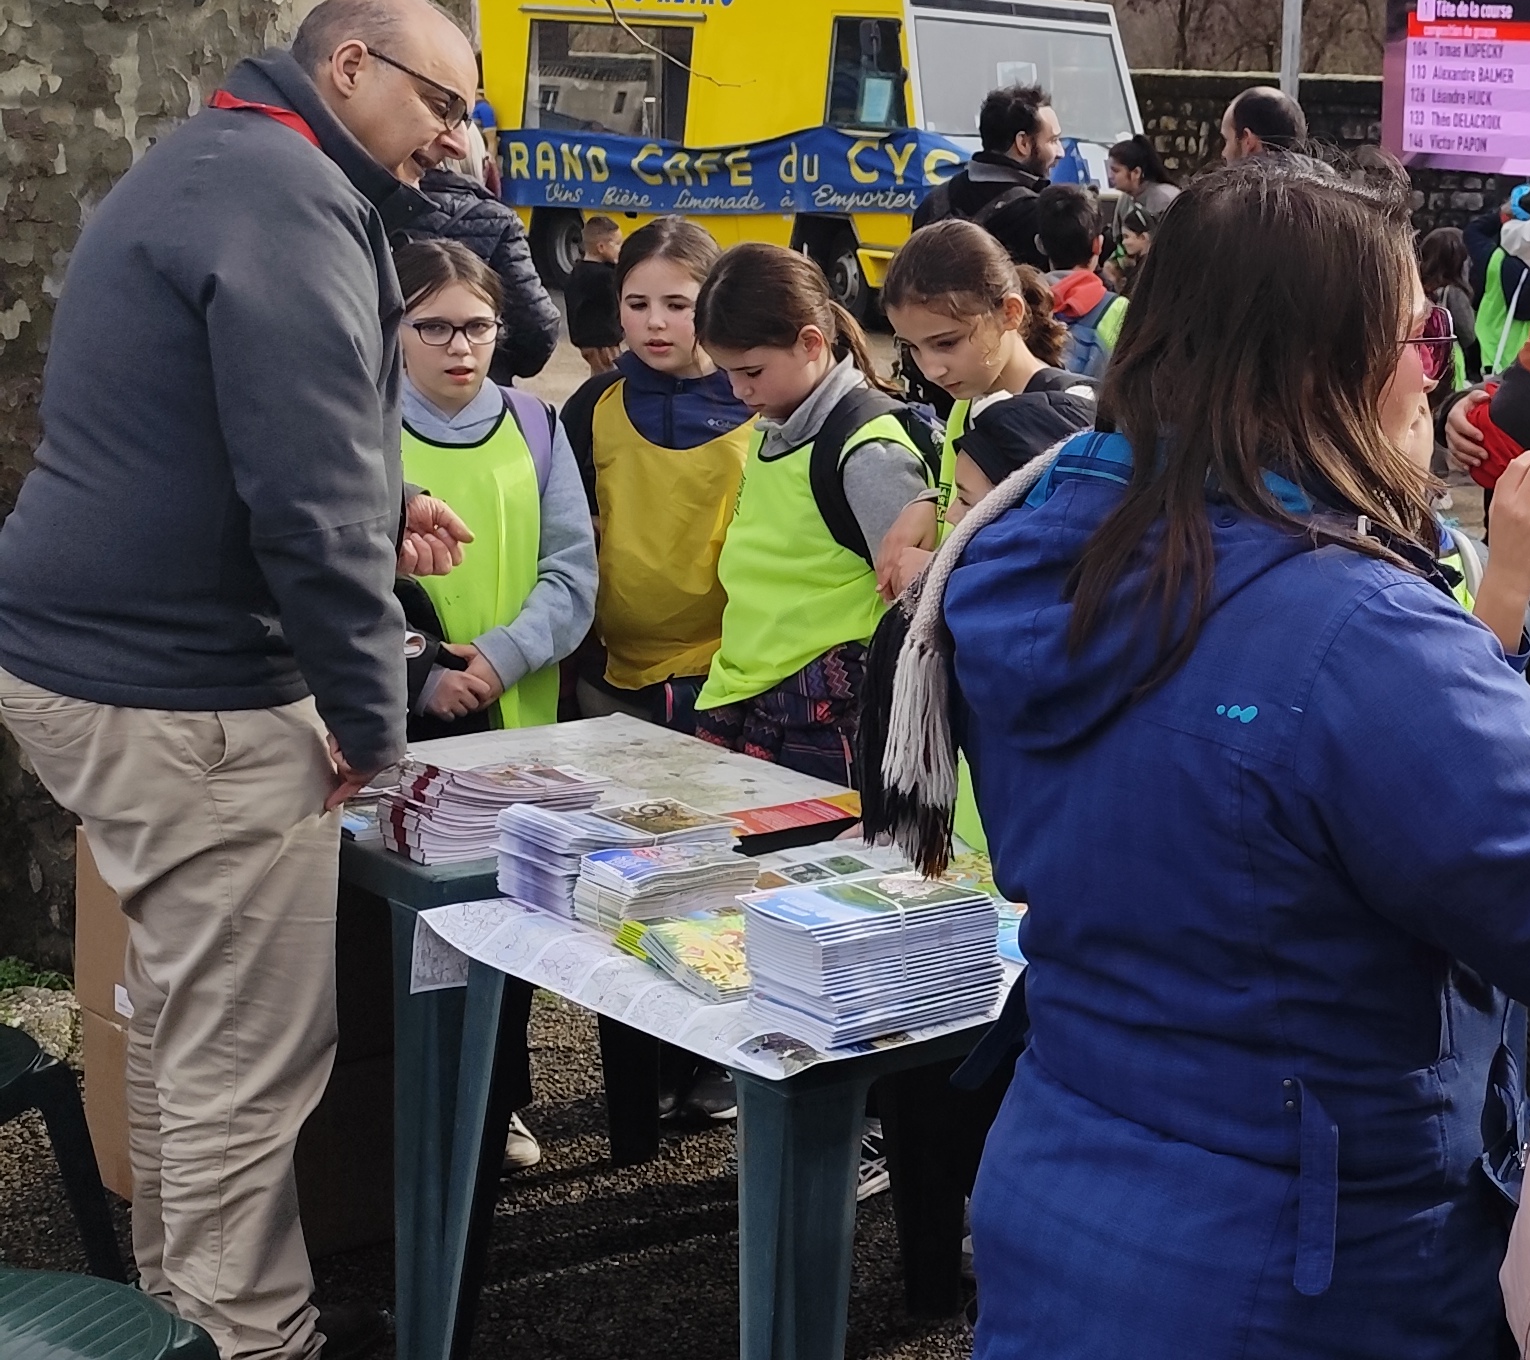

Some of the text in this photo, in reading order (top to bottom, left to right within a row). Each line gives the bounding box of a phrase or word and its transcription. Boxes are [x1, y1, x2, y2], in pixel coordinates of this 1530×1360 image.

[1457, 1, 1469, 18] de
[1470, 0, 1480, 18] la
[1432, 65, 1476, 82] Alexandre
[1478, 67, 1515, 84] BALMER
[499, 141, 610, 183] RAND
[779, 142, 819, 184] du
[847, 139, 961, 186] CYC
[601, 189, 653, 207] Bière
[673, 188, 765, 210] Limonade
[780, 190, 794, 208] à
[812, 184, 920, 213] Emporter
